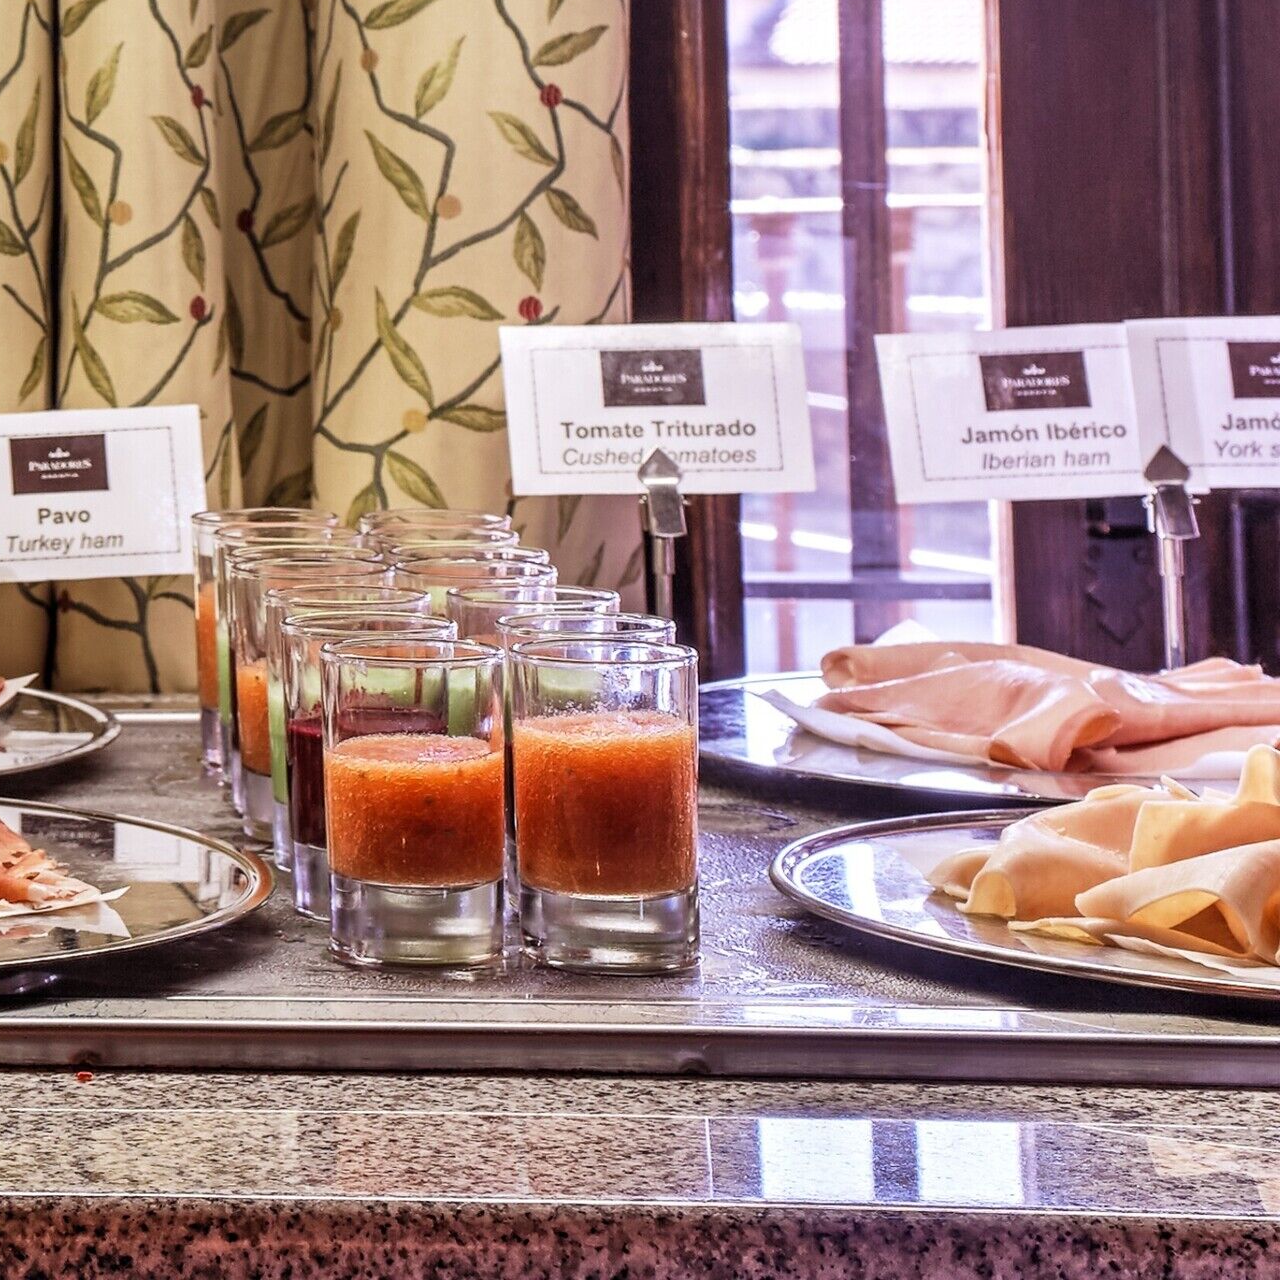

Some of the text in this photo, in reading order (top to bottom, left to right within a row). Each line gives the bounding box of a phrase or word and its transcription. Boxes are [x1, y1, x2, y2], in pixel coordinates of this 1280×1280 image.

[560, 418, 757, 440] Tomate Triturado
[962, 421, 1128, 445] Jamón Ibérico
[562, 446, 757, 466] Cushed omatoes
[982, 449, 1112, 471] Iberian ham
[1213, 439, 1263, 459] York
[37, 507, 91, 525] Pavo
[6, 532, 125, 556] Turkey ham
